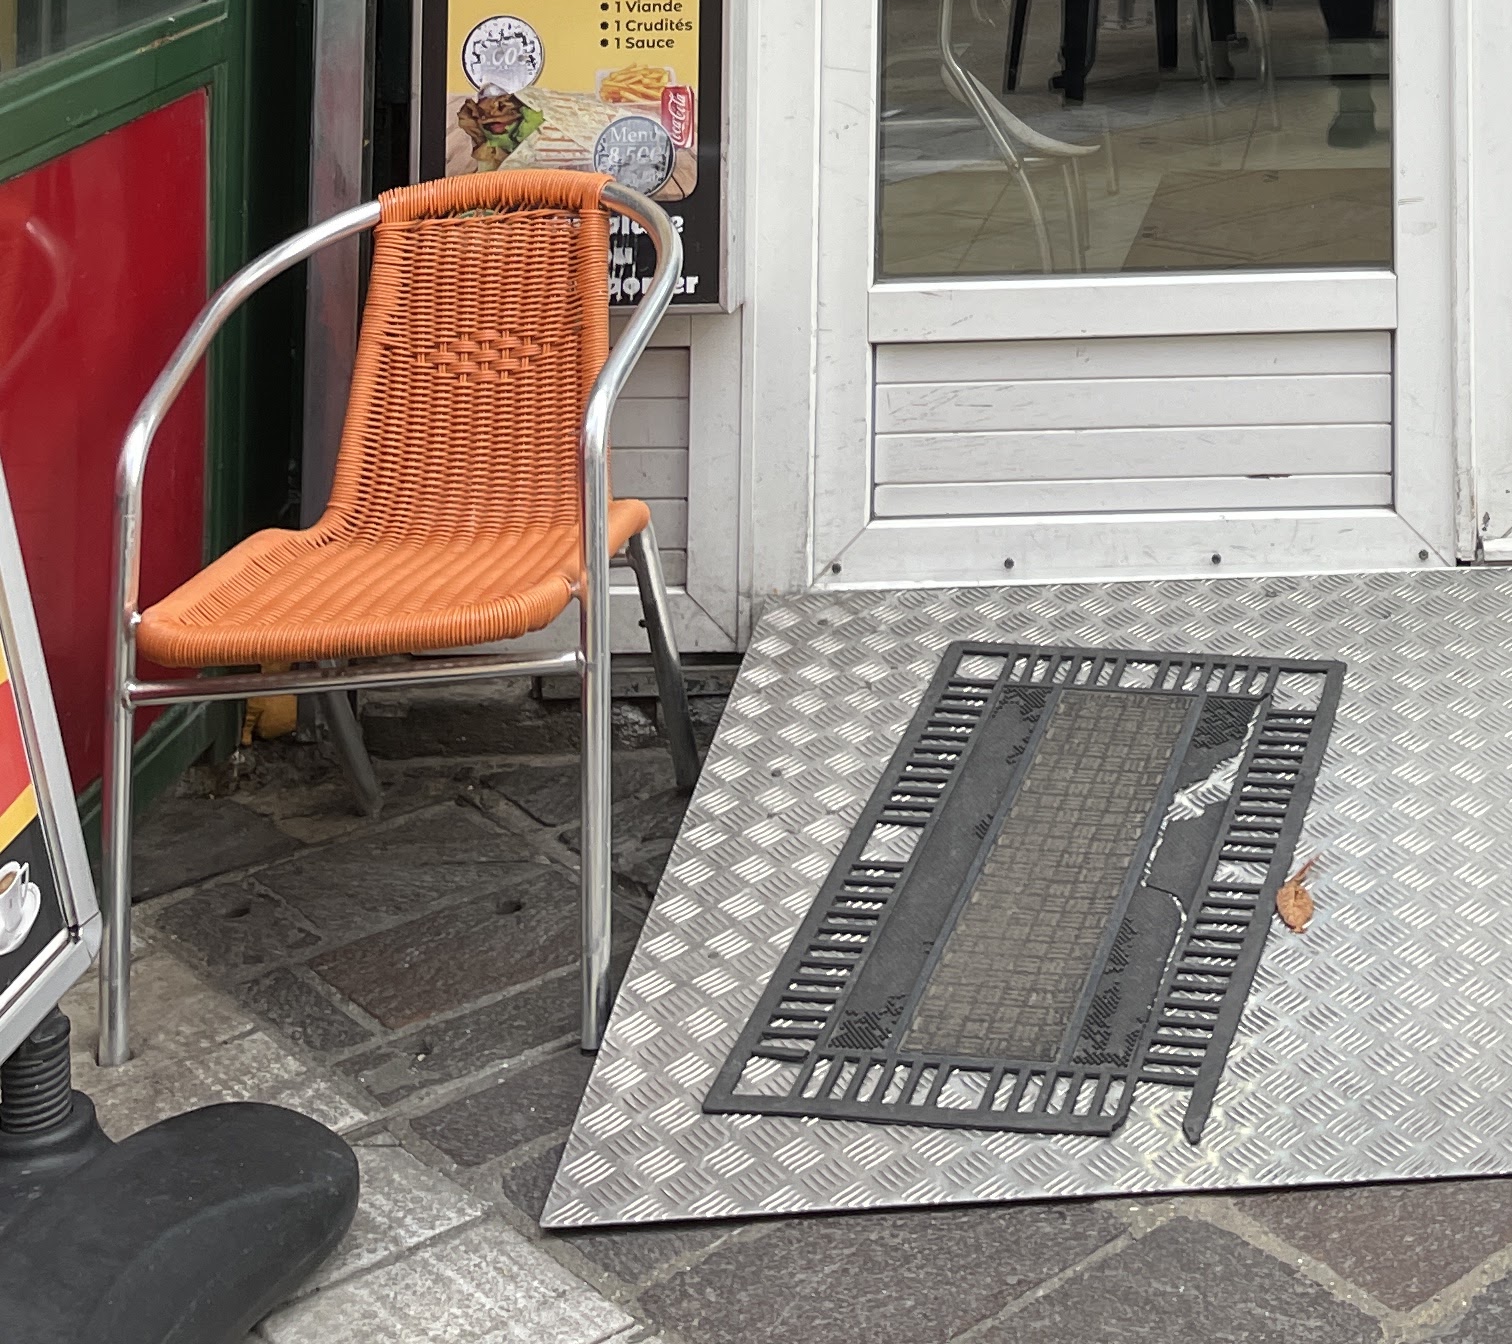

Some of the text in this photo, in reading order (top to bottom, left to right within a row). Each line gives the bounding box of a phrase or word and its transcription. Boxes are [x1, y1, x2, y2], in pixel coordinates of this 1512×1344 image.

[615, 0, 683, 13] 1 Viande
[615, 18, 693, 32] 1 Crudités
